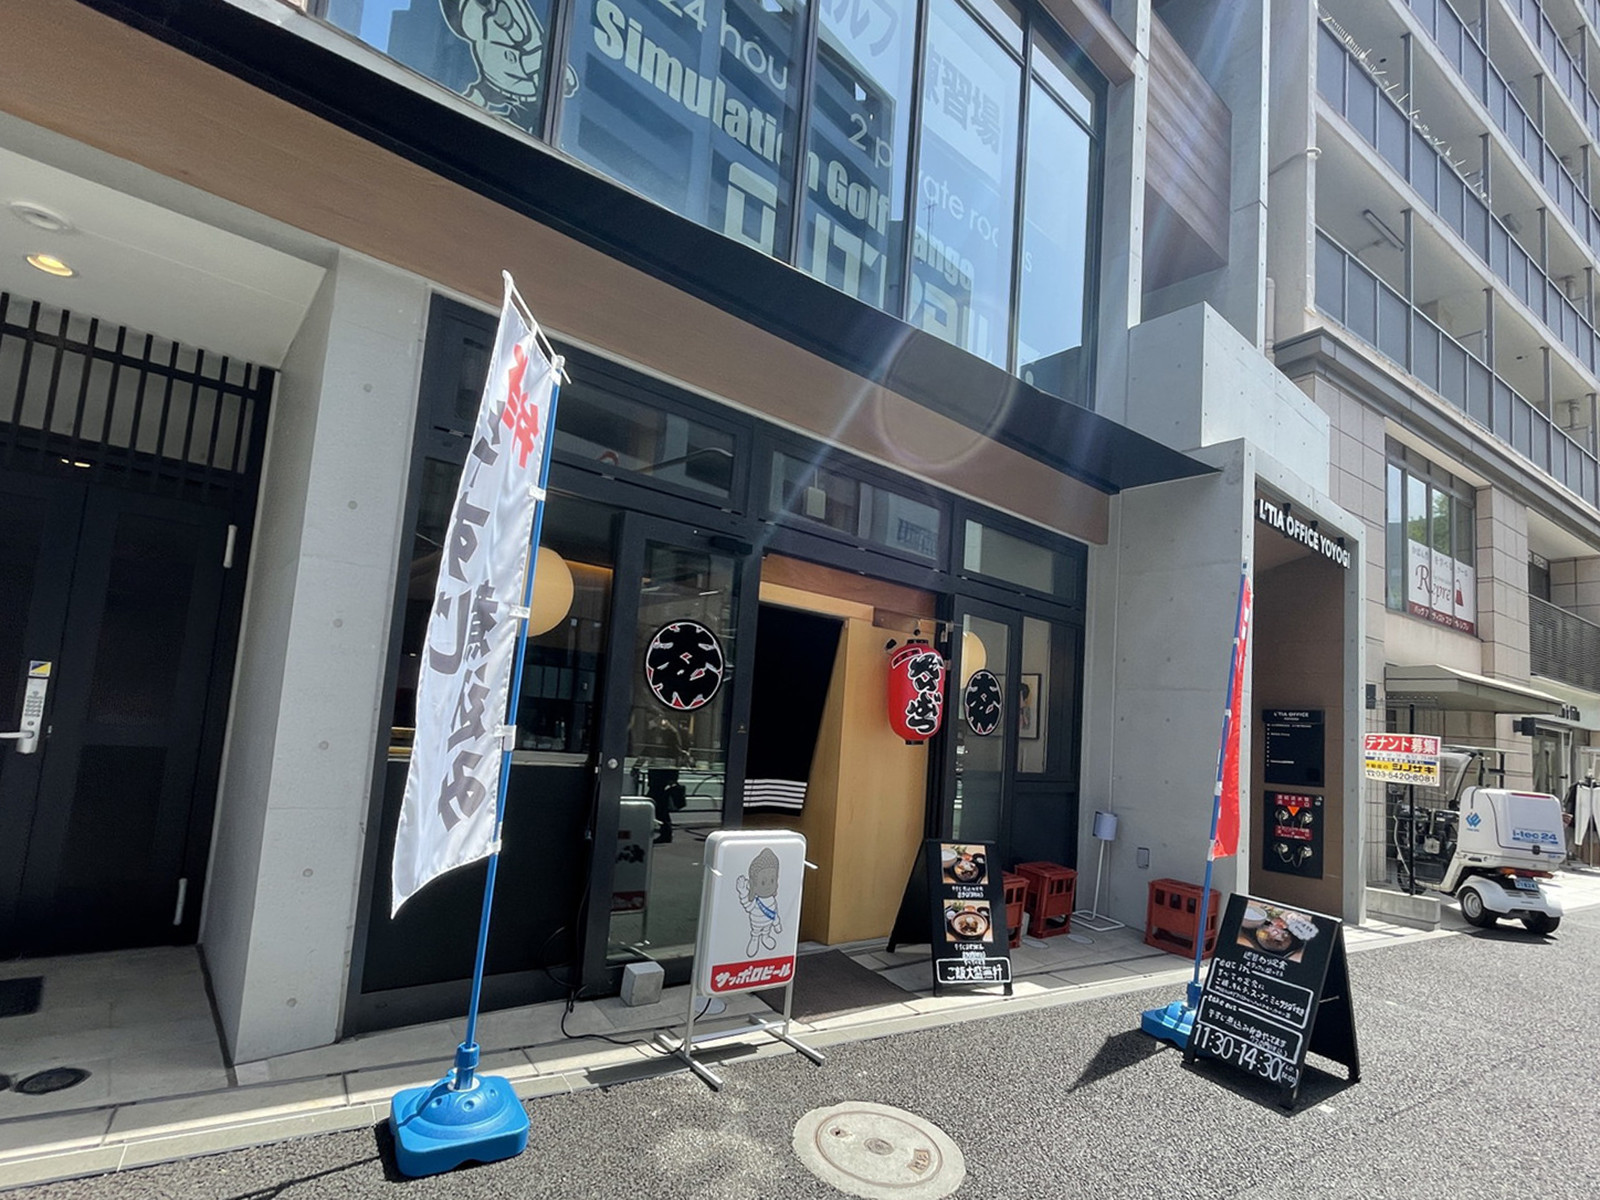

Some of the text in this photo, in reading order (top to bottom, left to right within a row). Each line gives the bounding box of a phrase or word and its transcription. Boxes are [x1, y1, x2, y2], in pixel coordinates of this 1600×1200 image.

[720, 10, 788, 91] hou
[847, 112, 868, 150] 2
[826, 159, 890, 236] Golf
[913, 224, 976, 292] ange
[1286, 515, 1319, 551] OFFICE
[1319, 534, 1351, 569] YOYOGI
[1366, 735, 1437, 755] テナント募集
[715, 962, 792, 988] サッポロビール
[1194, 1024, 1282, 1081] 11:30-14:30
